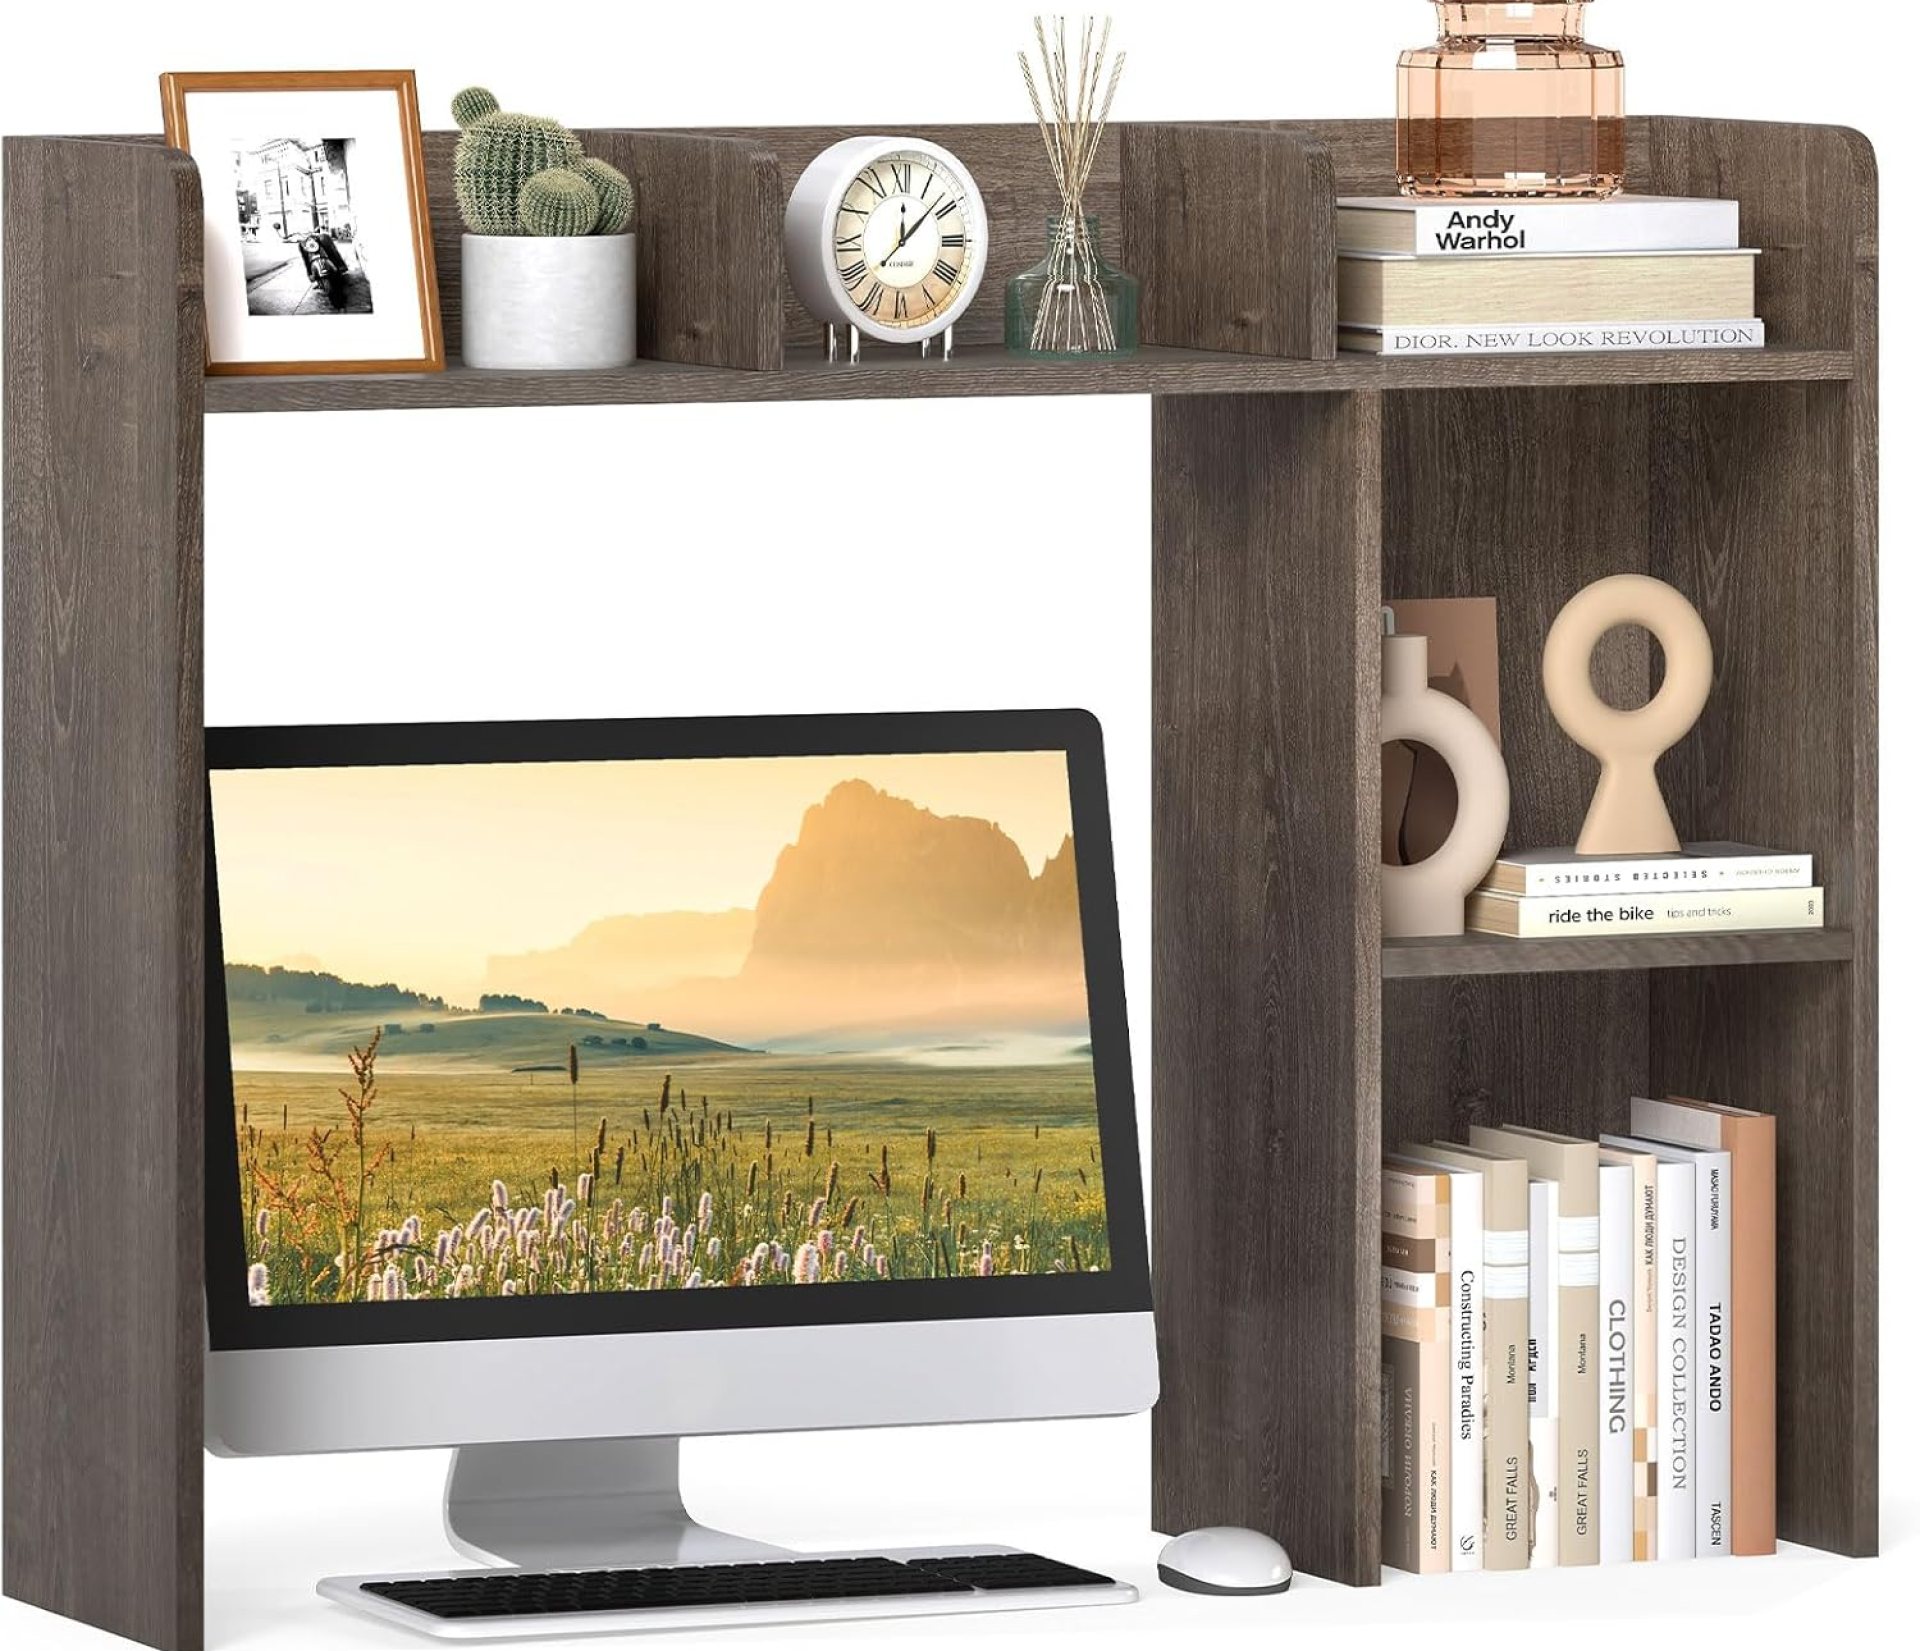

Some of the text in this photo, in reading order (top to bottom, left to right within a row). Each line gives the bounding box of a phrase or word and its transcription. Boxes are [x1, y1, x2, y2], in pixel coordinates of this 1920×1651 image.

[1435, 229, 1526, 251] Warhol
[1446, 209, 1516, 233] Andy
[1394, 327, 1754, 350] DIOR. NEW LOOK REVOLUTION
[1554, 869, 1708, 885] SELECTED STORIES
[1548, 905, 1732, 924] ride the bike tips and tricks
[1644, 1184, 1655, 1220] ДУМАЮТ
[1644, 1221, 1655, 1247] ЛЮДИ
[1644, 1248, 1654, 1266] КАК
[1457, 1270, 1475, 1370] Constructing
[1506, 1344, 1516, 1385] Montana
[1577, 1333, 1587, 1374] Montana
[1608, 1299, 1627, 1434] CLOTHING
[1672, 1237, 1688, 1490] DESIGN COLLECTION
[1709, 1302, 1722, 1413] TADAO ANDO
[1505, 1456, 1518, 1541] GREAT FALLS
[1576, 1448, 1588, 1536] GREAT FALLS
[1710, 1501, 1722, 1546] TASCEN
